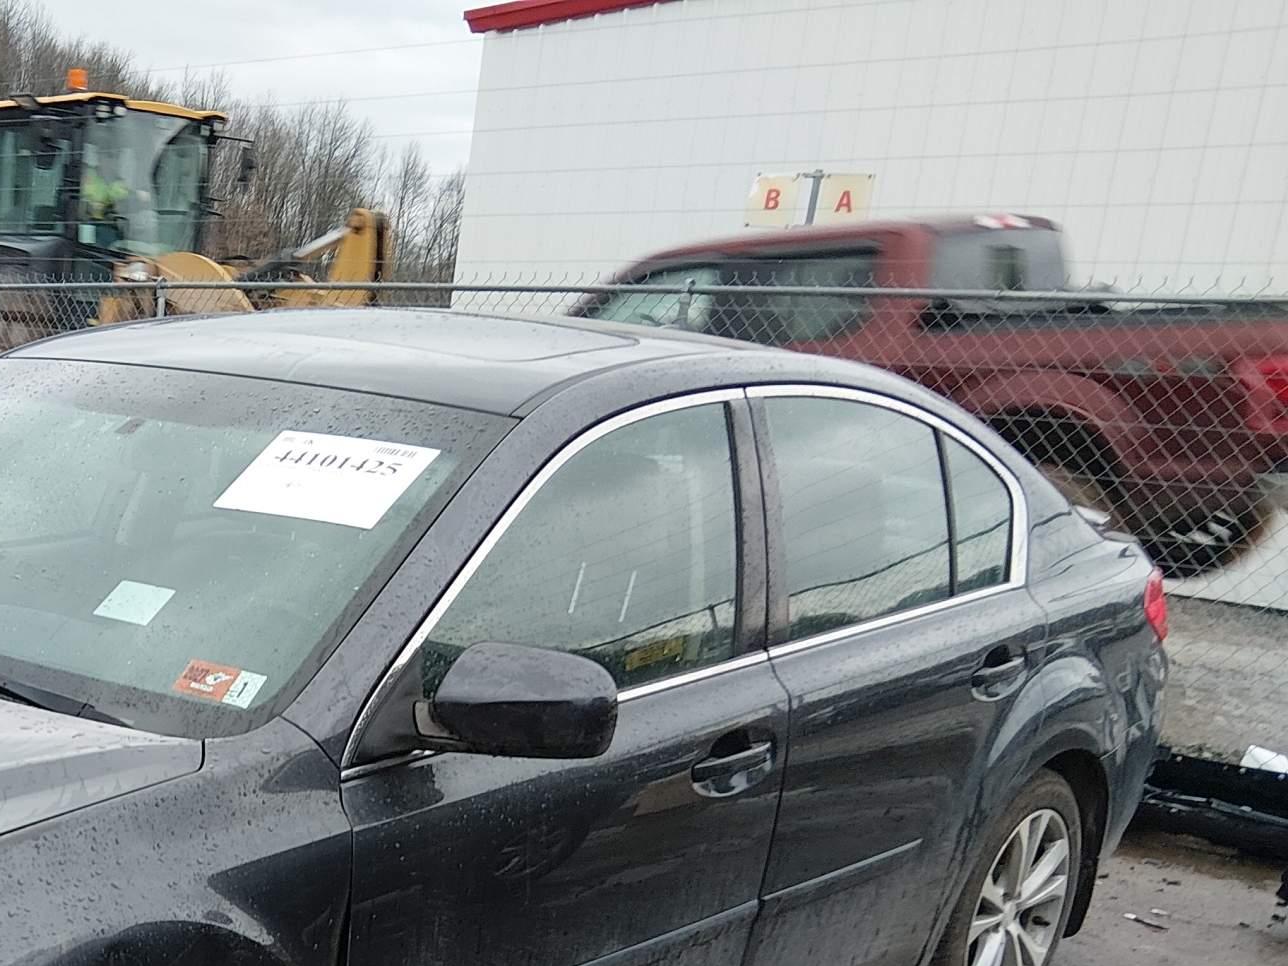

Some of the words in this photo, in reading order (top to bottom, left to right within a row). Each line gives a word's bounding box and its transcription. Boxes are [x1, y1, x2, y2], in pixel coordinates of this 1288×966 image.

[763, 188, 781, 210] B
[834, 190, 852, 213] A
[274, 450, 403, 476] 44101425
